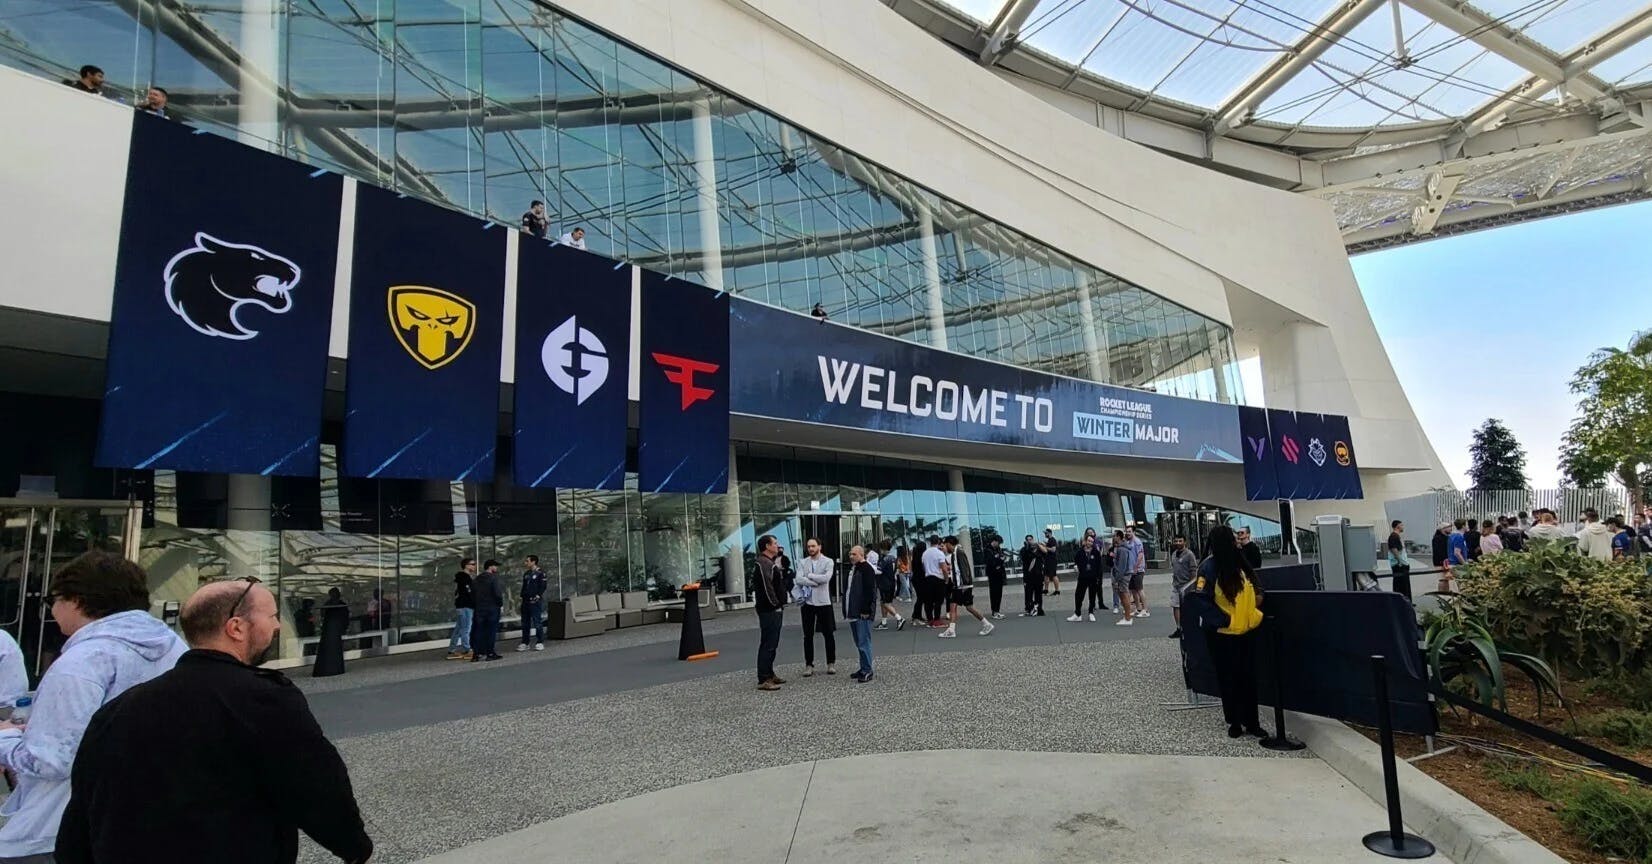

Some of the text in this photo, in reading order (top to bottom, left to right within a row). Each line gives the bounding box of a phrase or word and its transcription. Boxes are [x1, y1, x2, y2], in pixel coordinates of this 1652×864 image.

[818, 355, 1054, 432] WELCOME TO
[1100, 397, 1152, 413] ROCKET LEAGUE
[1077, 416, 1179, 443] WINTER MAJOR
